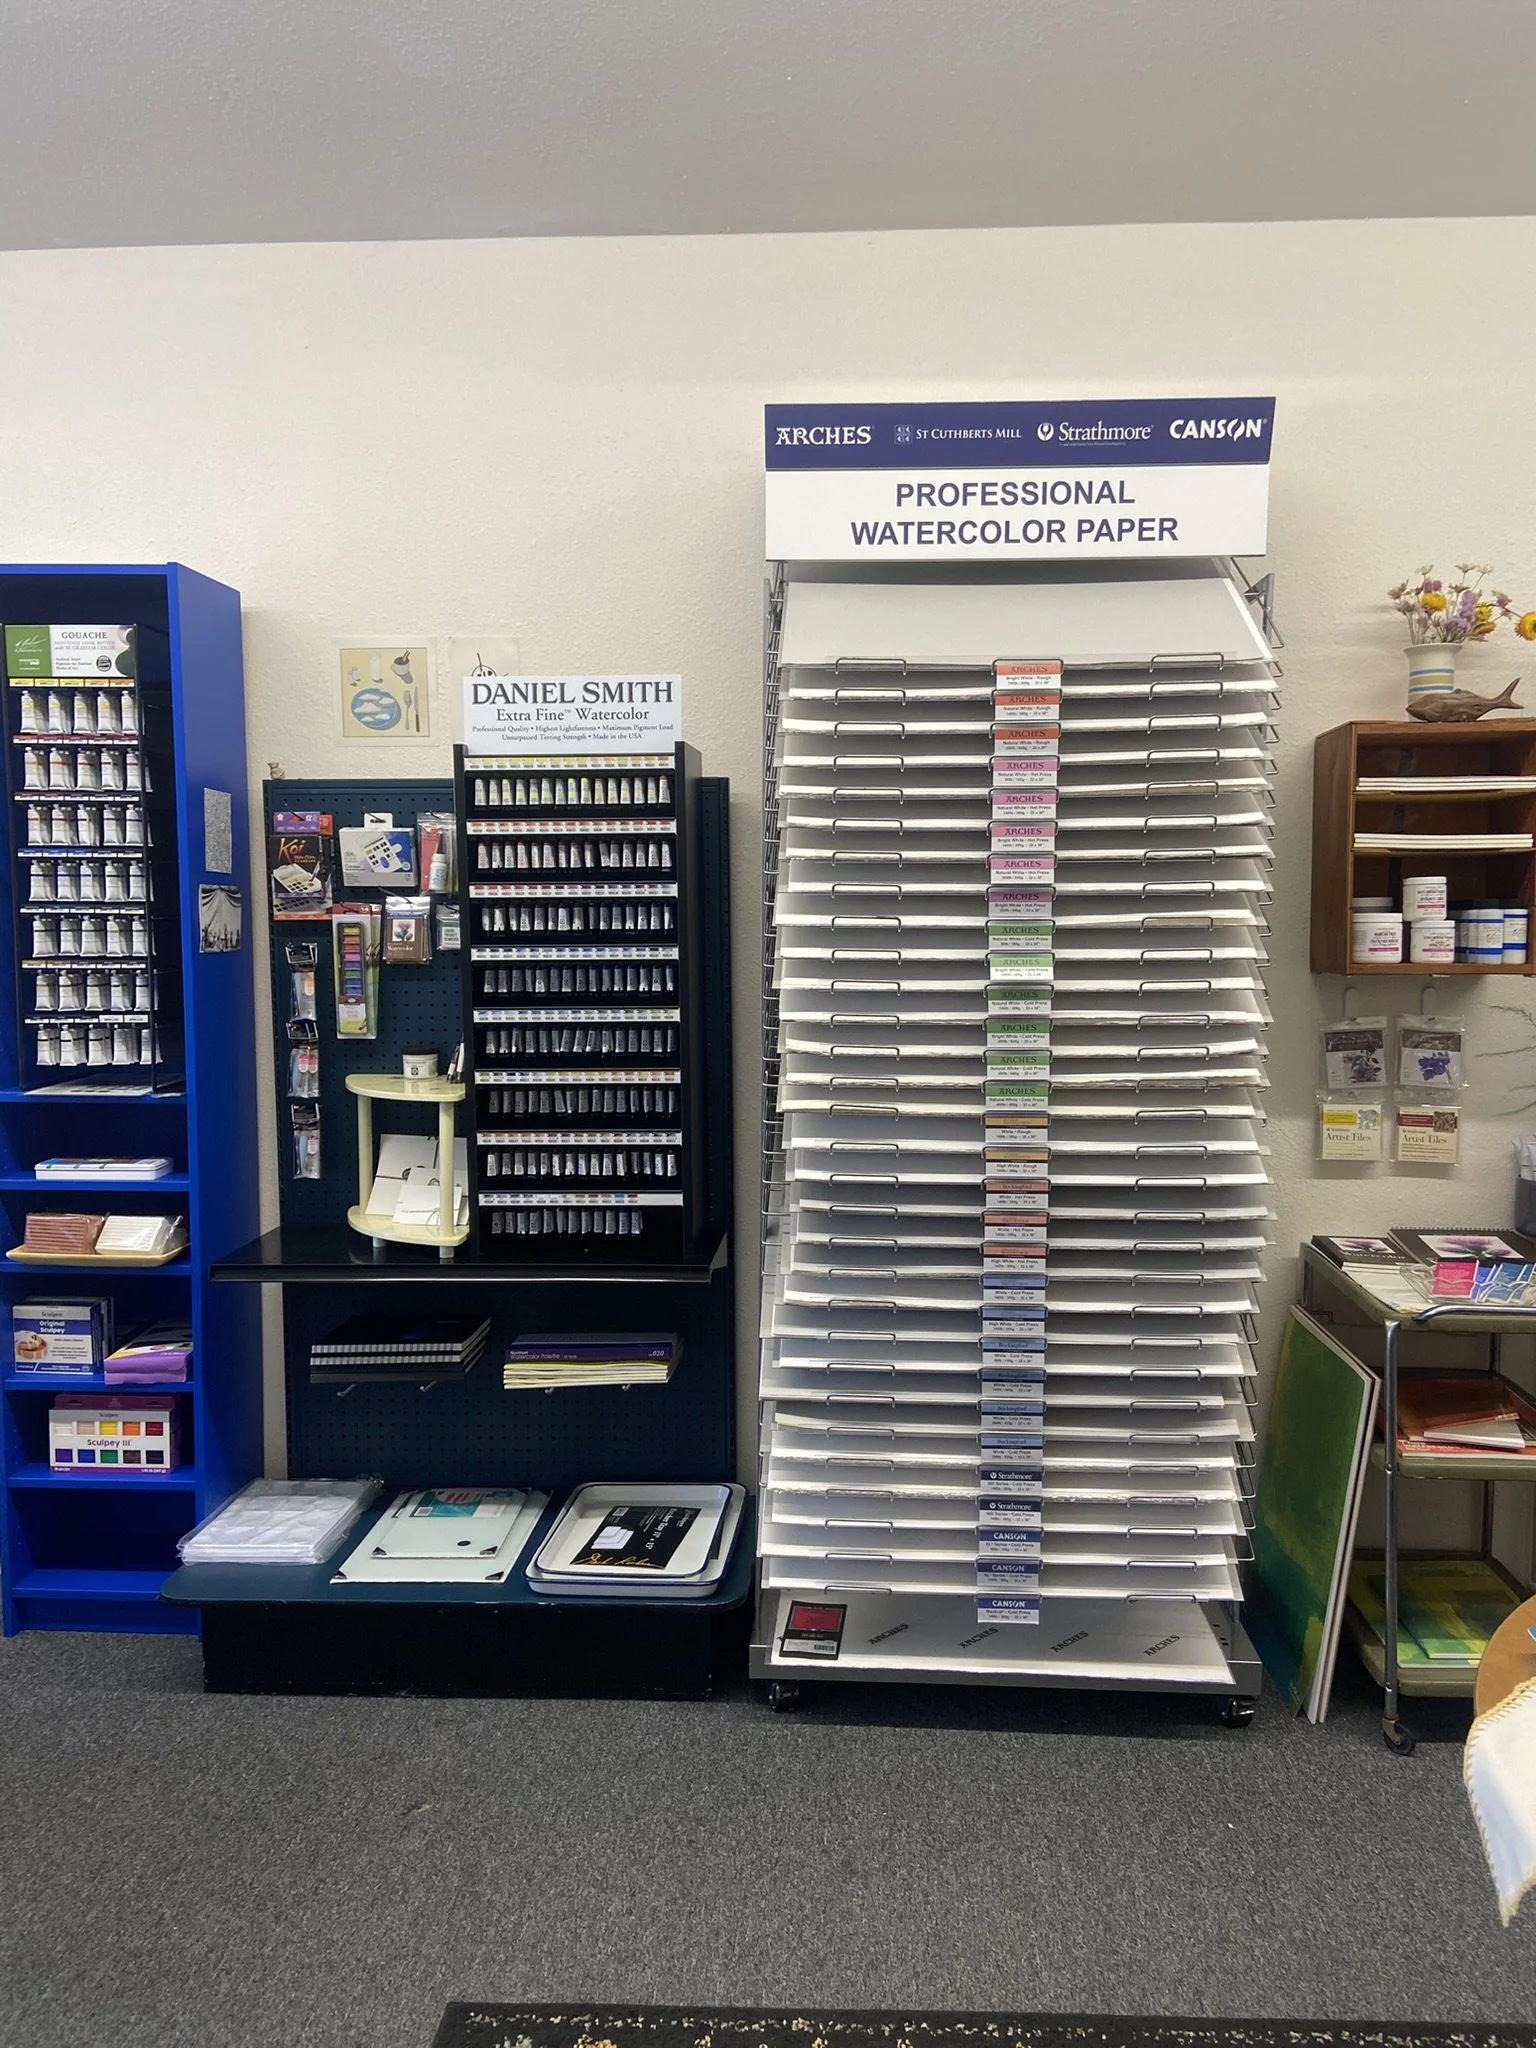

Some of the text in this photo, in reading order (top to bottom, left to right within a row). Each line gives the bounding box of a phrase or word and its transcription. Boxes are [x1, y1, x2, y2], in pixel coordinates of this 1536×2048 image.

[776, 426, 872, 446] ARCHES
[931, 427, 992, 440] CUTHBERTS
[995, 426, 1022, 439] MILL
[1059, 422, 1152, 442] Strathmore
[1170, 418, 1262, 440] CANSON
[896, 481, 1136, 508] PROFESSIONAL
[851, 517, 1179, 546] WATERCOLOR PAPER
[61, 631, 108, 639] GOUACHE
[472, 681, 673, 705] DANIEL SMITH
[496, 708, 531, 721] Extra
[575, 706, 650, 720] Watercolor
[508, 725, 529, 733] Quality
[535, 725, 558, 733] Highest
[633, 724, 657, 732] Pigment
[540, 734, 561, 742] Tinting
[562, 733, 587, 741] Strength
[278, 837, 306, 864] Koi
[1326, 1132, 1371, 1141] Artist Tiles
[1403, 1135, 1447, 1143] Artist Tiles
[87, 1439, 120, 1448] Sculpey
[998, 1472, 1032, 1480] Strathmore
[997, 1502, 1032, 1510] Strathmore
[994, 1532, 1027, 1540] CANSON
[992, 1600, 1026, 1608] CANSON
[868, 1622, 909, 1645] ARCHES
[958, 1626, 998, 1649] ARCHES
[1050, 1630, 1089, 1653] ARCHES
[1143, 1633, 1180, 1656] ARCHES
